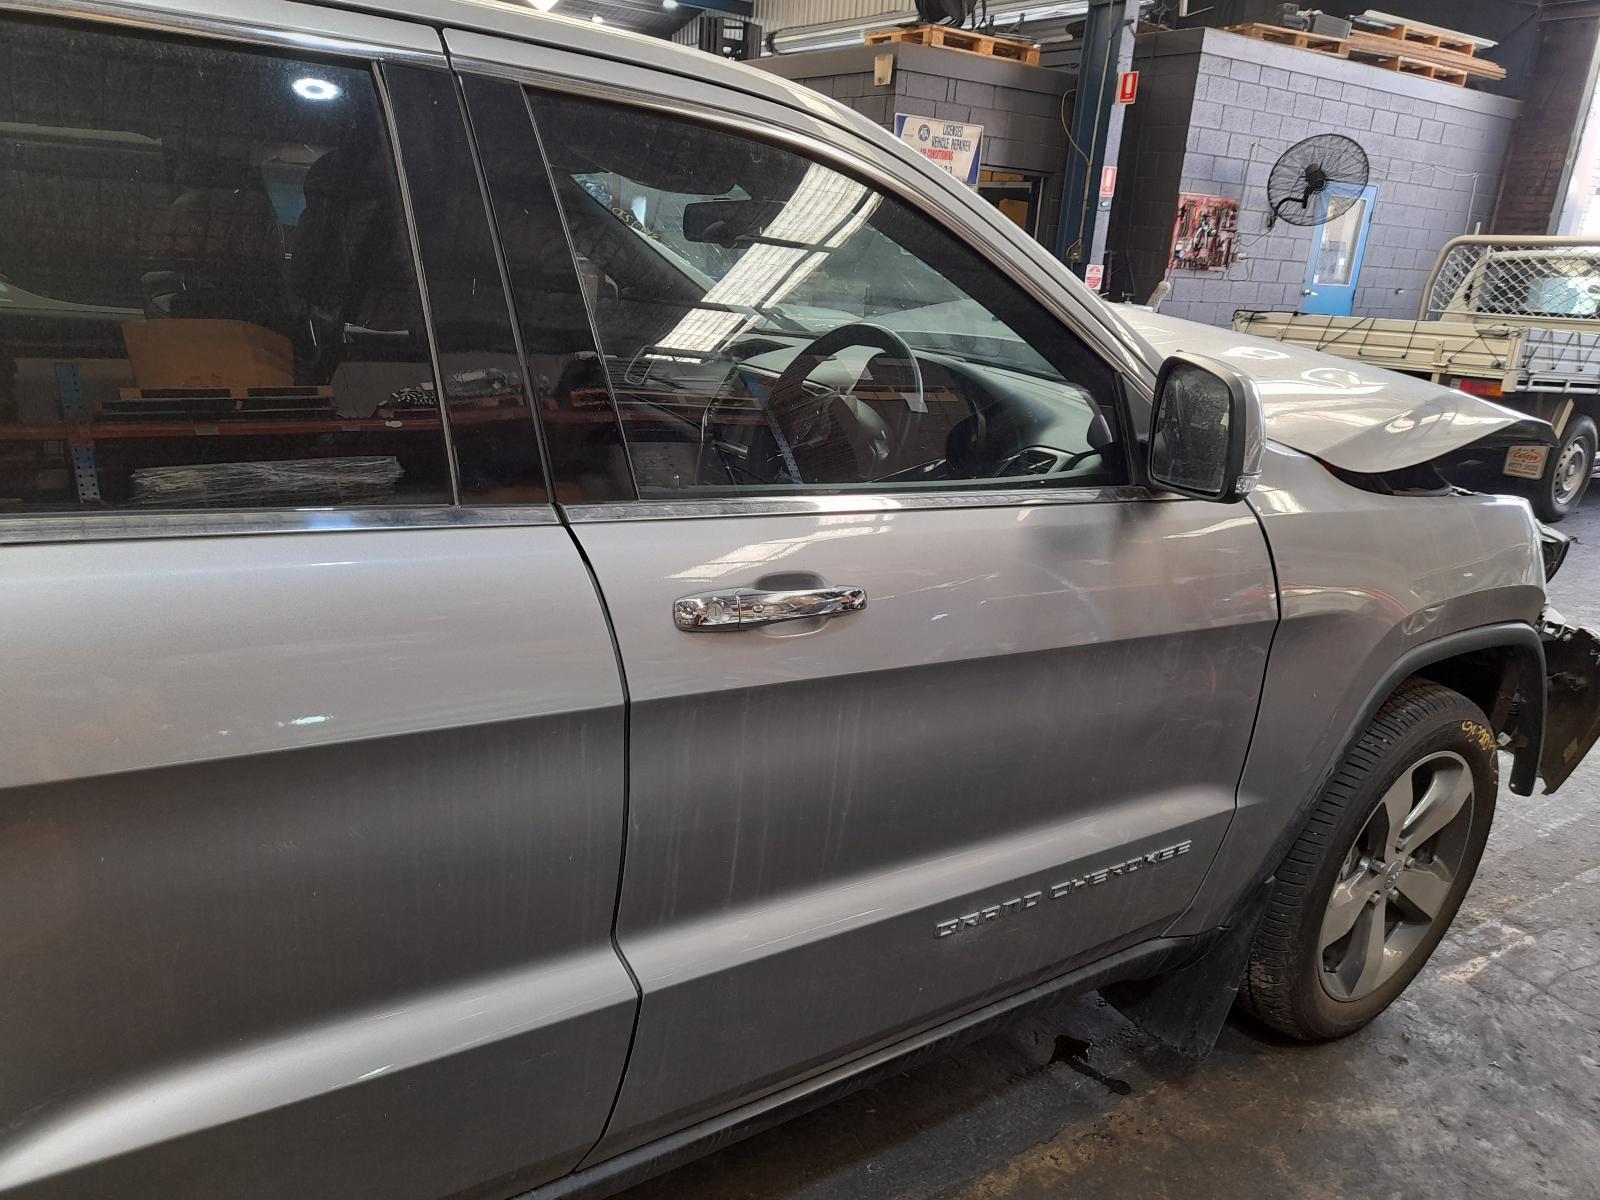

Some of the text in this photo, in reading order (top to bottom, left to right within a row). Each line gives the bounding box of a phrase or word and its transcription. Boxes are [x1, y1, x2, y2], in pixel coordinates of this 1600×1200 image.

[932, 136, 971, 152] VEHICLE REPAIRER
[934, 839, 1192, 938] GRAND CHEROKEE
